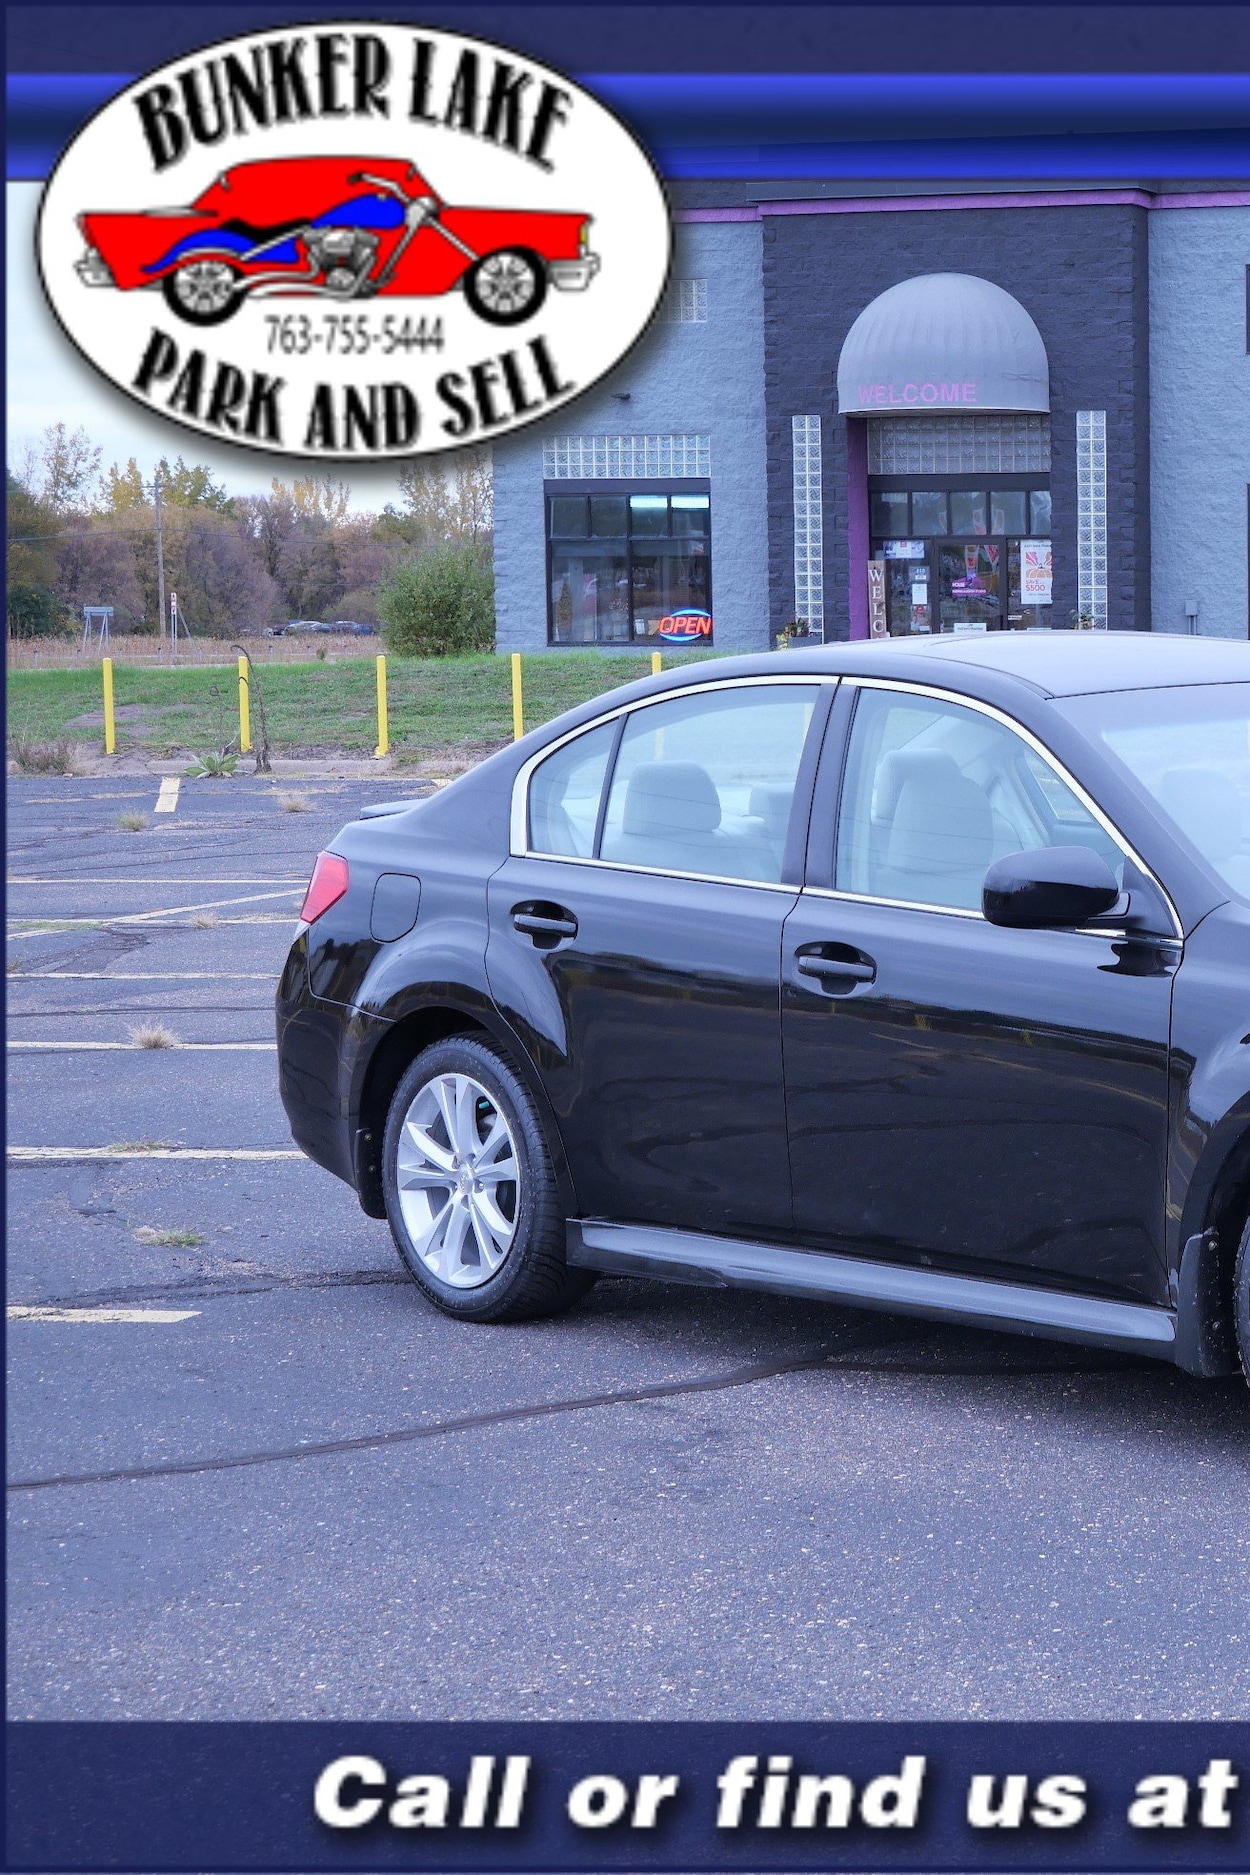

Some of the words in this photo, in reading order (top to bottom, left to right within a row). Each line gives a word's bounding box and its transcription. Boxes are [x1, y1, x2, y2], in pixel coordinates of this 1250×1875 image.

[858, 383, 977, 404] WELCOME
[869, 569, 885, 634] WELC
[659, 616, 711, 634] OPEN
